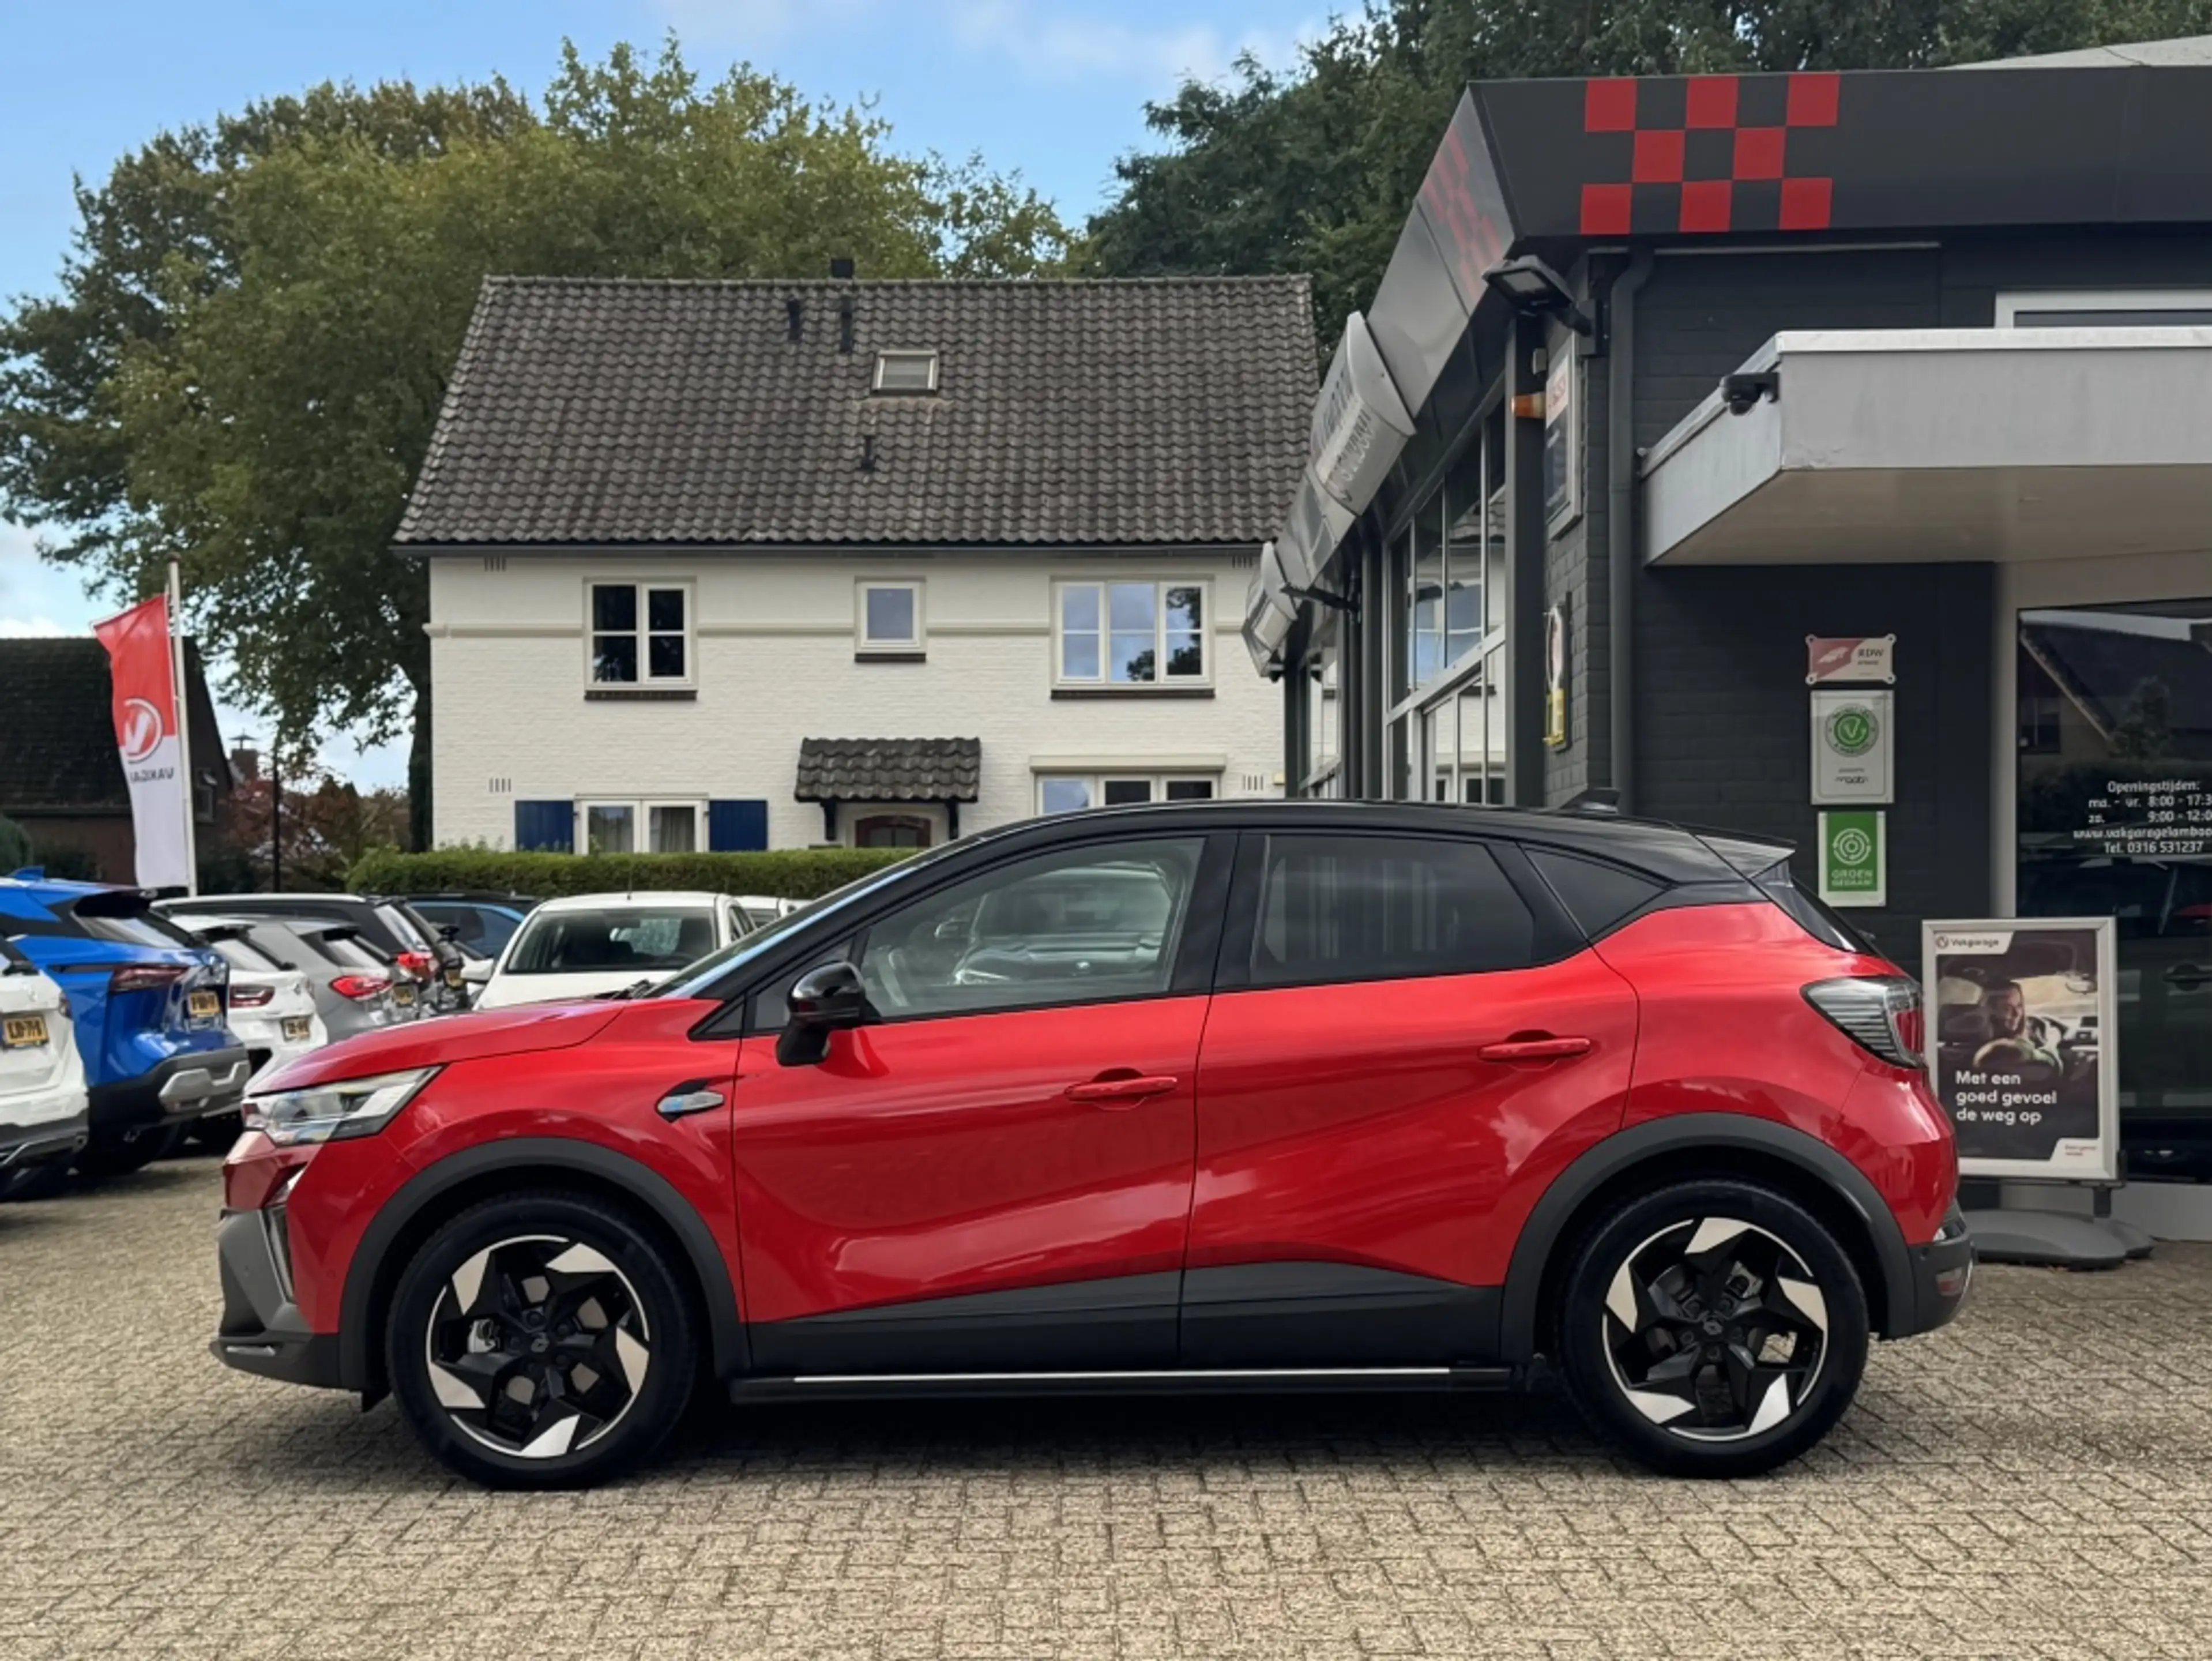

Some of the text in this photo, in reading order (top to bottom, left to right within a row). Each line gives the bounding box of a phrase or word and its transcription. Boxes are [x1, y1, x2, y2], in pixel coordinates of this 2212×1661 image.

[2108, 780, 2200, 794] Openingstijden:
[2148, 796, 2175, 807] 8:00
[2147, 810, 2175, 822] 9:00
[2105, 841, 2204, 853] Tel. 0316 531237
[1831, 869, 1873, 879] GROEN
[1955, 1070, 2021, 1084] Met een
[1956, 1089, 2057, 1107] goed gevoel
[1956, 1107, 2042, 1125] de weg op
